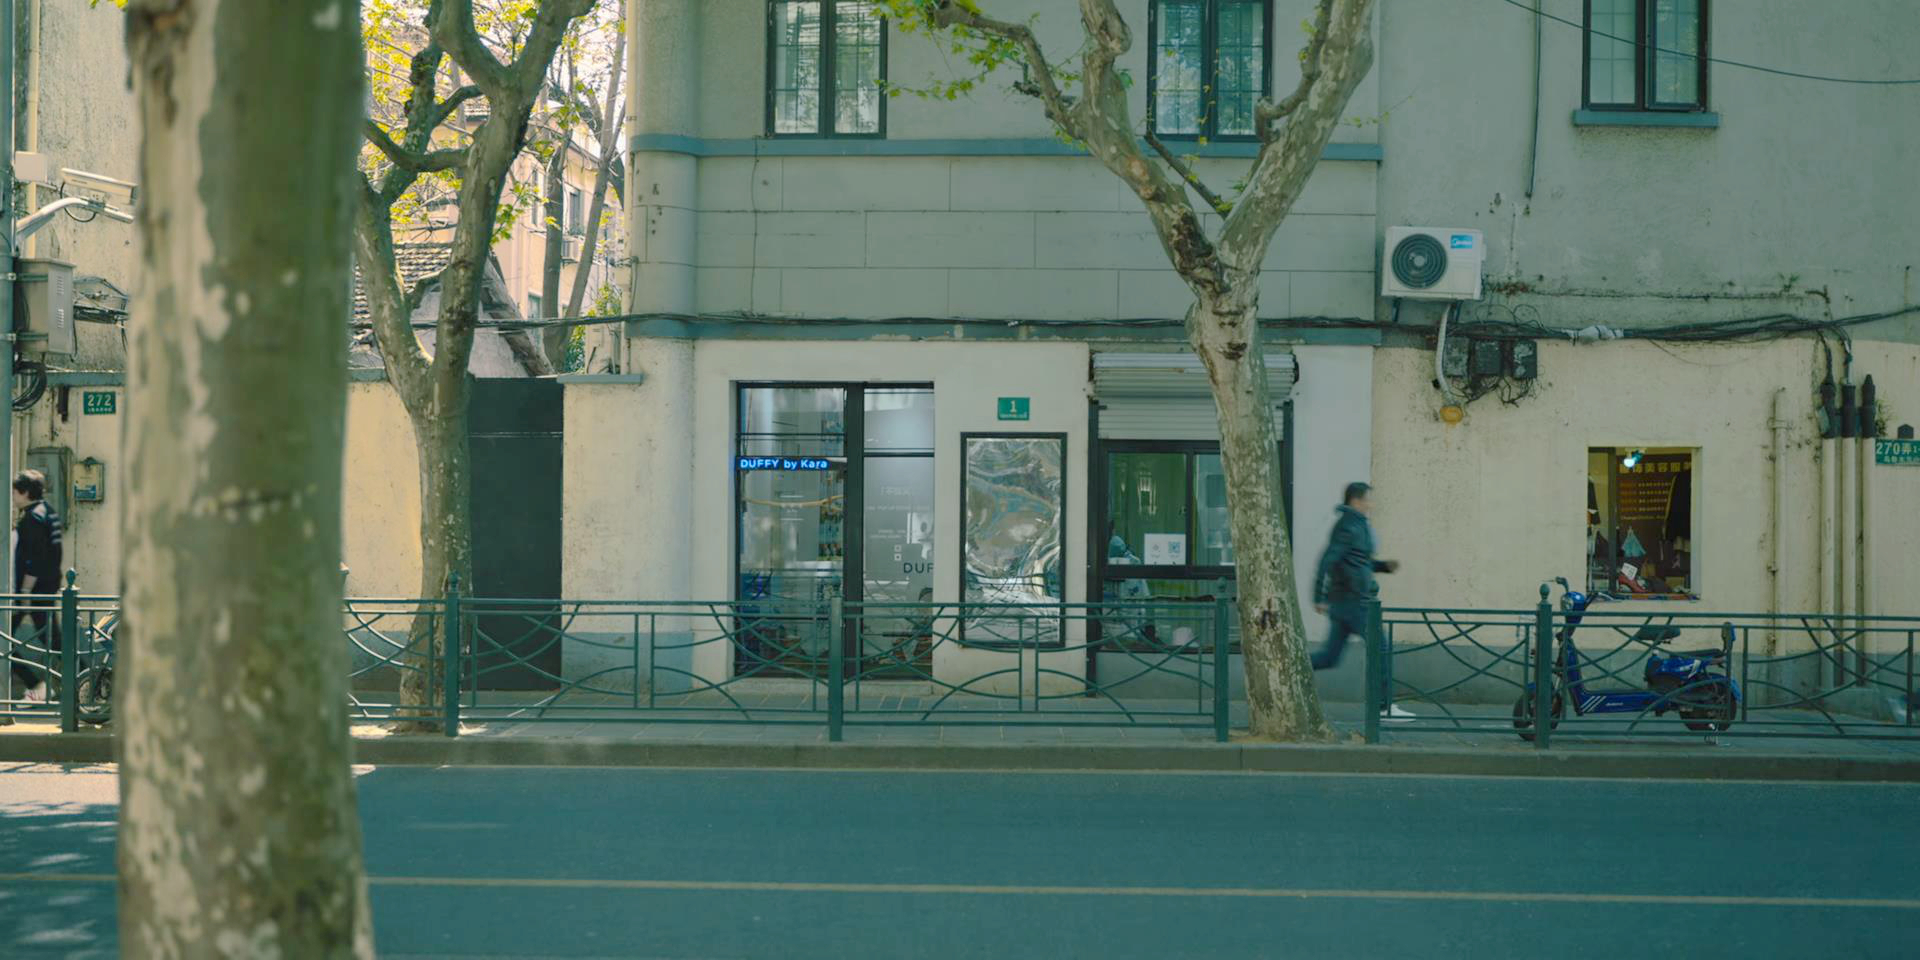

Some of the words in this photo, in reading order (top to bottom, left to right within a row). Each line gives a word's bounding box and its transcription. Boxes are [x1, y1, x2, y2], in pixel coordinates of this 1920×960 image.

[87, 394, 112, 407] 272
[1010, 400, 1017, 413] 1
[740, 459, 780, 469] DUFFY
[784, 459, 797, 470] by
[800, 459, 828, 469] Kara
